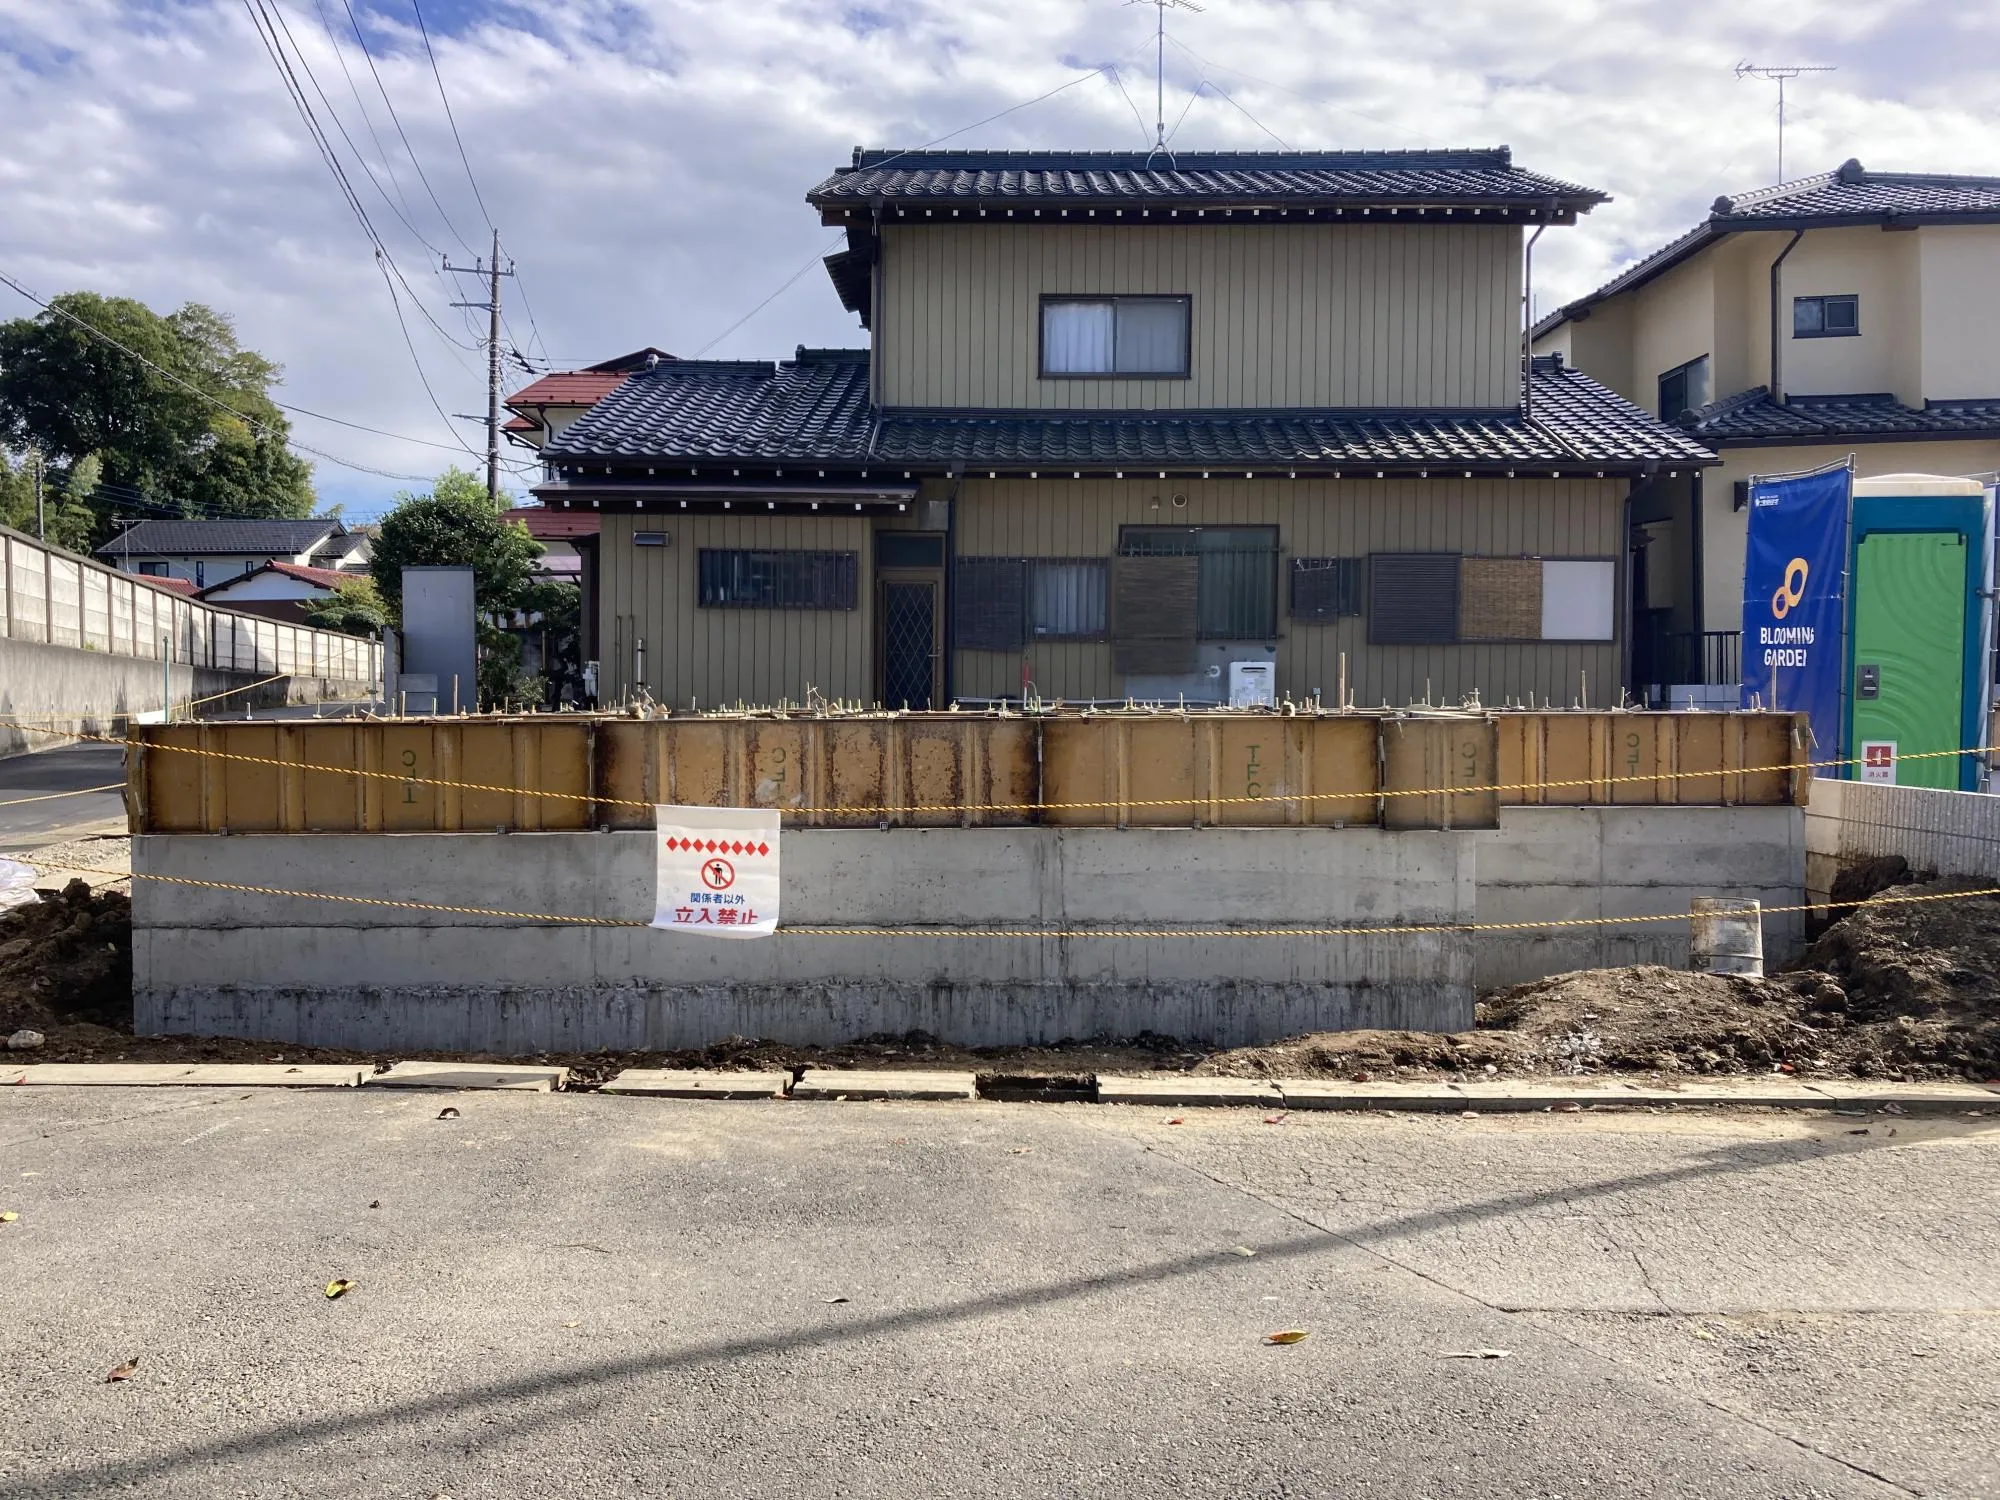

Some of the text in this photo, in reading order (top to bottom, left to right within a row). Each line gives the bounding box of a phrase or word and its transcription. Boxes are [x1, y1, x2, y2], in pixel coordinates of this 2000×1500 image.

[1246, 744, 1262, 799] TFC
[690, 892, 745, 905] 関係者以外
[672, 906, 759, 925] 立入禁止
